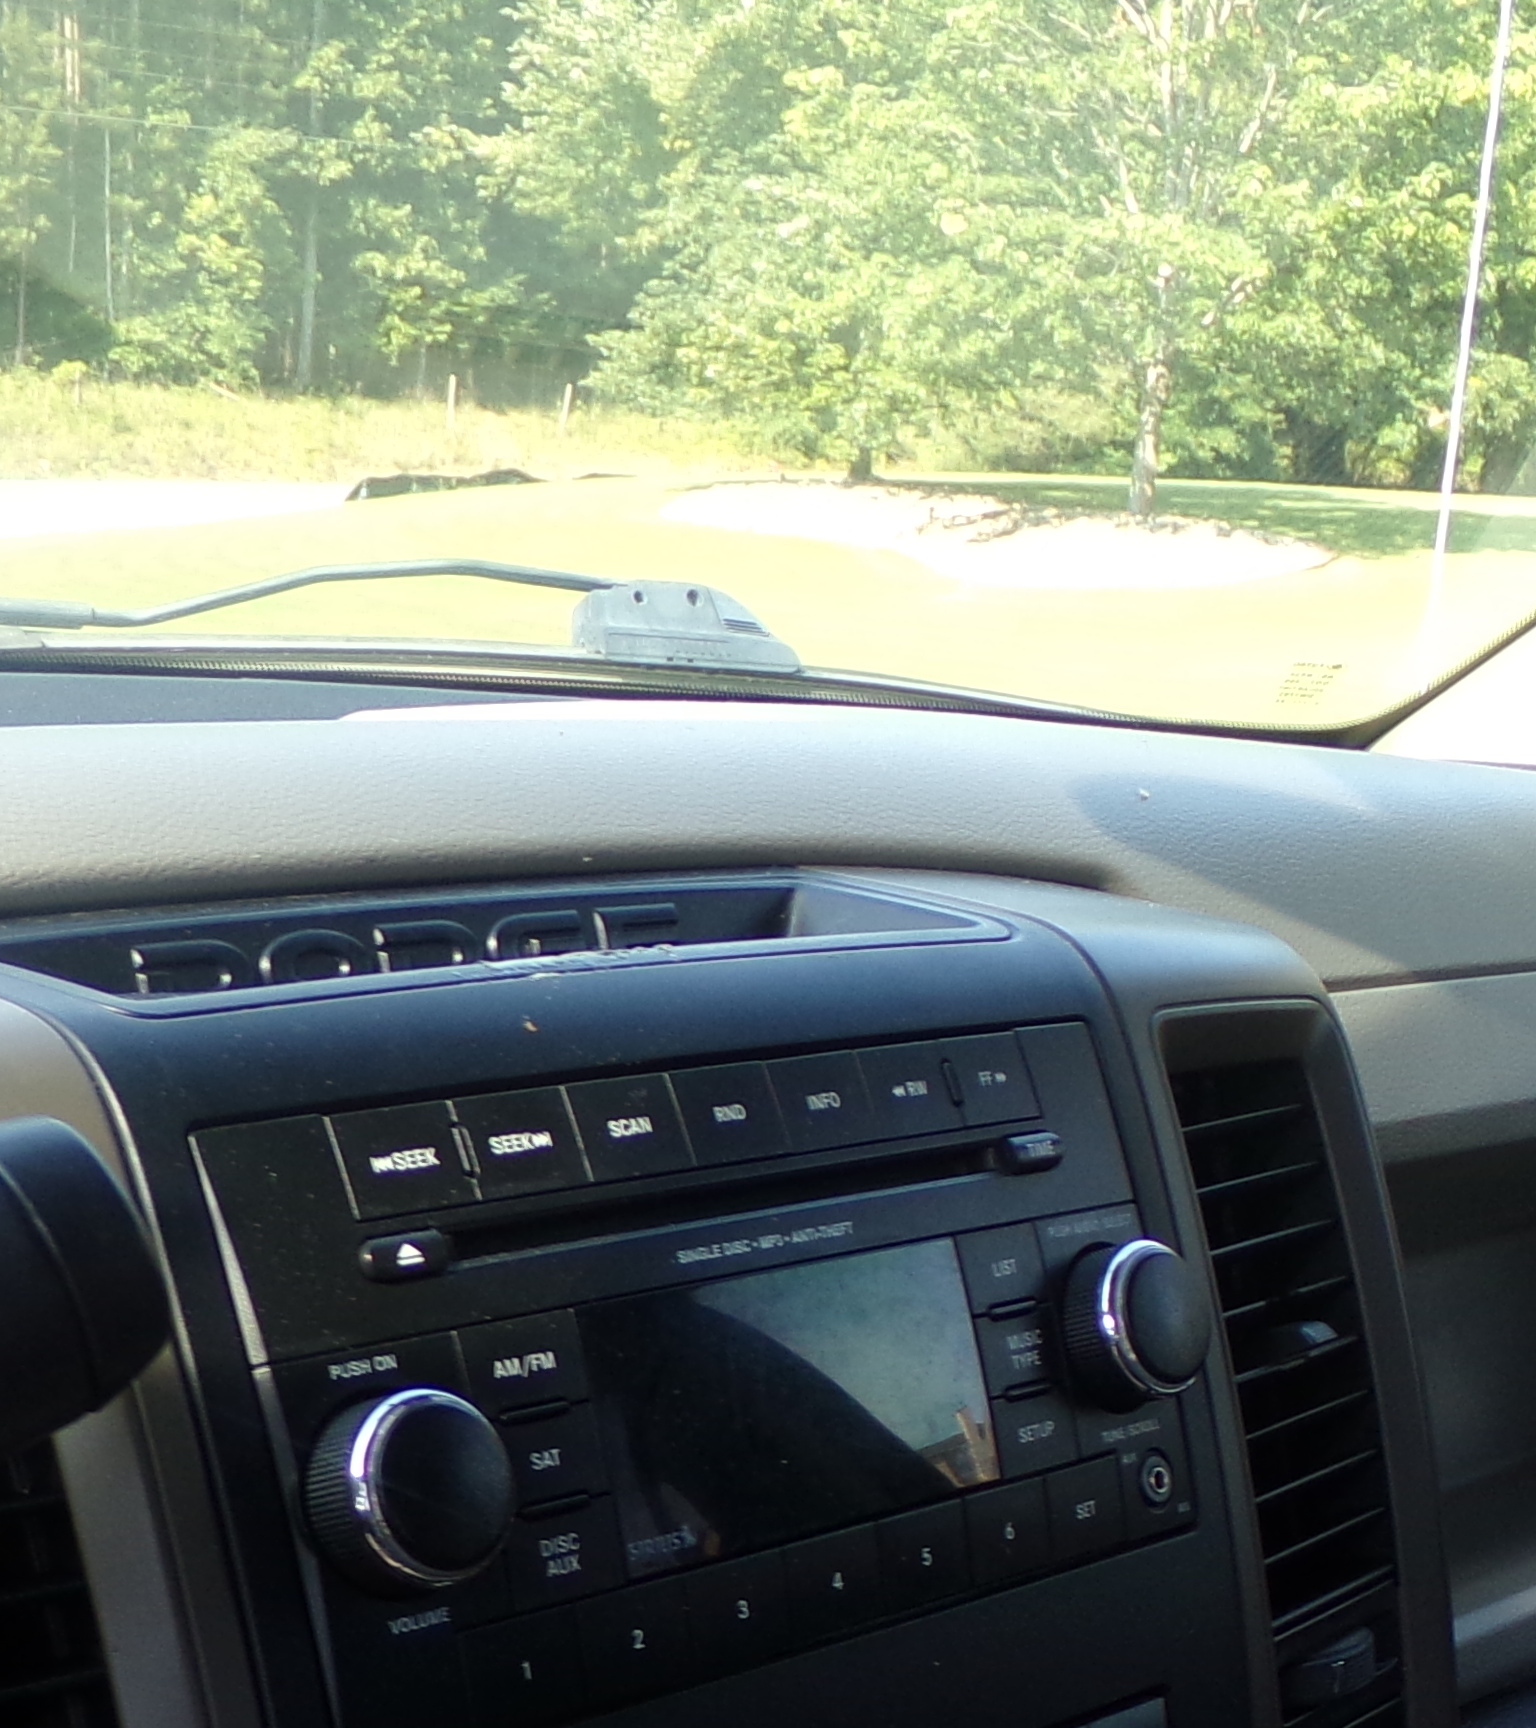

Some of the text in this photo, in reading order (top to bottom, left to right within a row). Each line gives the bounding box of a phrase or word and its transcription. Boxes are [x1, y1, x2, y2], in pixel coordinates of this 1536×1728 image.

[805, 1090, 842, 1111] INFO
[712, 1102, 748, 1123] RND
[606, 1115, 654, 1139] SCAN
[488, 1134, 536, 1156] SEEK
[391, 1146, 442, 1172] SEEK
[675, 1243, 723, 1264] SINGLE
[723, 1238, 752, 1256] DISC
[991, 1258, 1018, 1277] LIST
[1007, 1328, 1043, 1350] MUSIC
[327, 1353, 399, 1381] PUSH ON
[492, 1350, 558, 1379] AM/FM
[1011, 1350, 1042, 1369] TYPE
[1017, 1420, 1055, 1443] SETUP
[529, 1447, 562, 1471] SAT
[1075, 1499, 1097, 1519] SET
[1004, 1521, 1016, 1540] 6
[538, 1532, 582, 1557] DISC
[545, 1554, 582, 1578] AUX
[919, 1546, 933, 1567] 5
[830, 1570, 845, 1591] 4
[736, 1597, 752, 1621] 3
[387, 1606, 453, 1636] VOLUME
[631, 1626, 647, 1650] 2
[520, 1660, 533, 1681] 1
